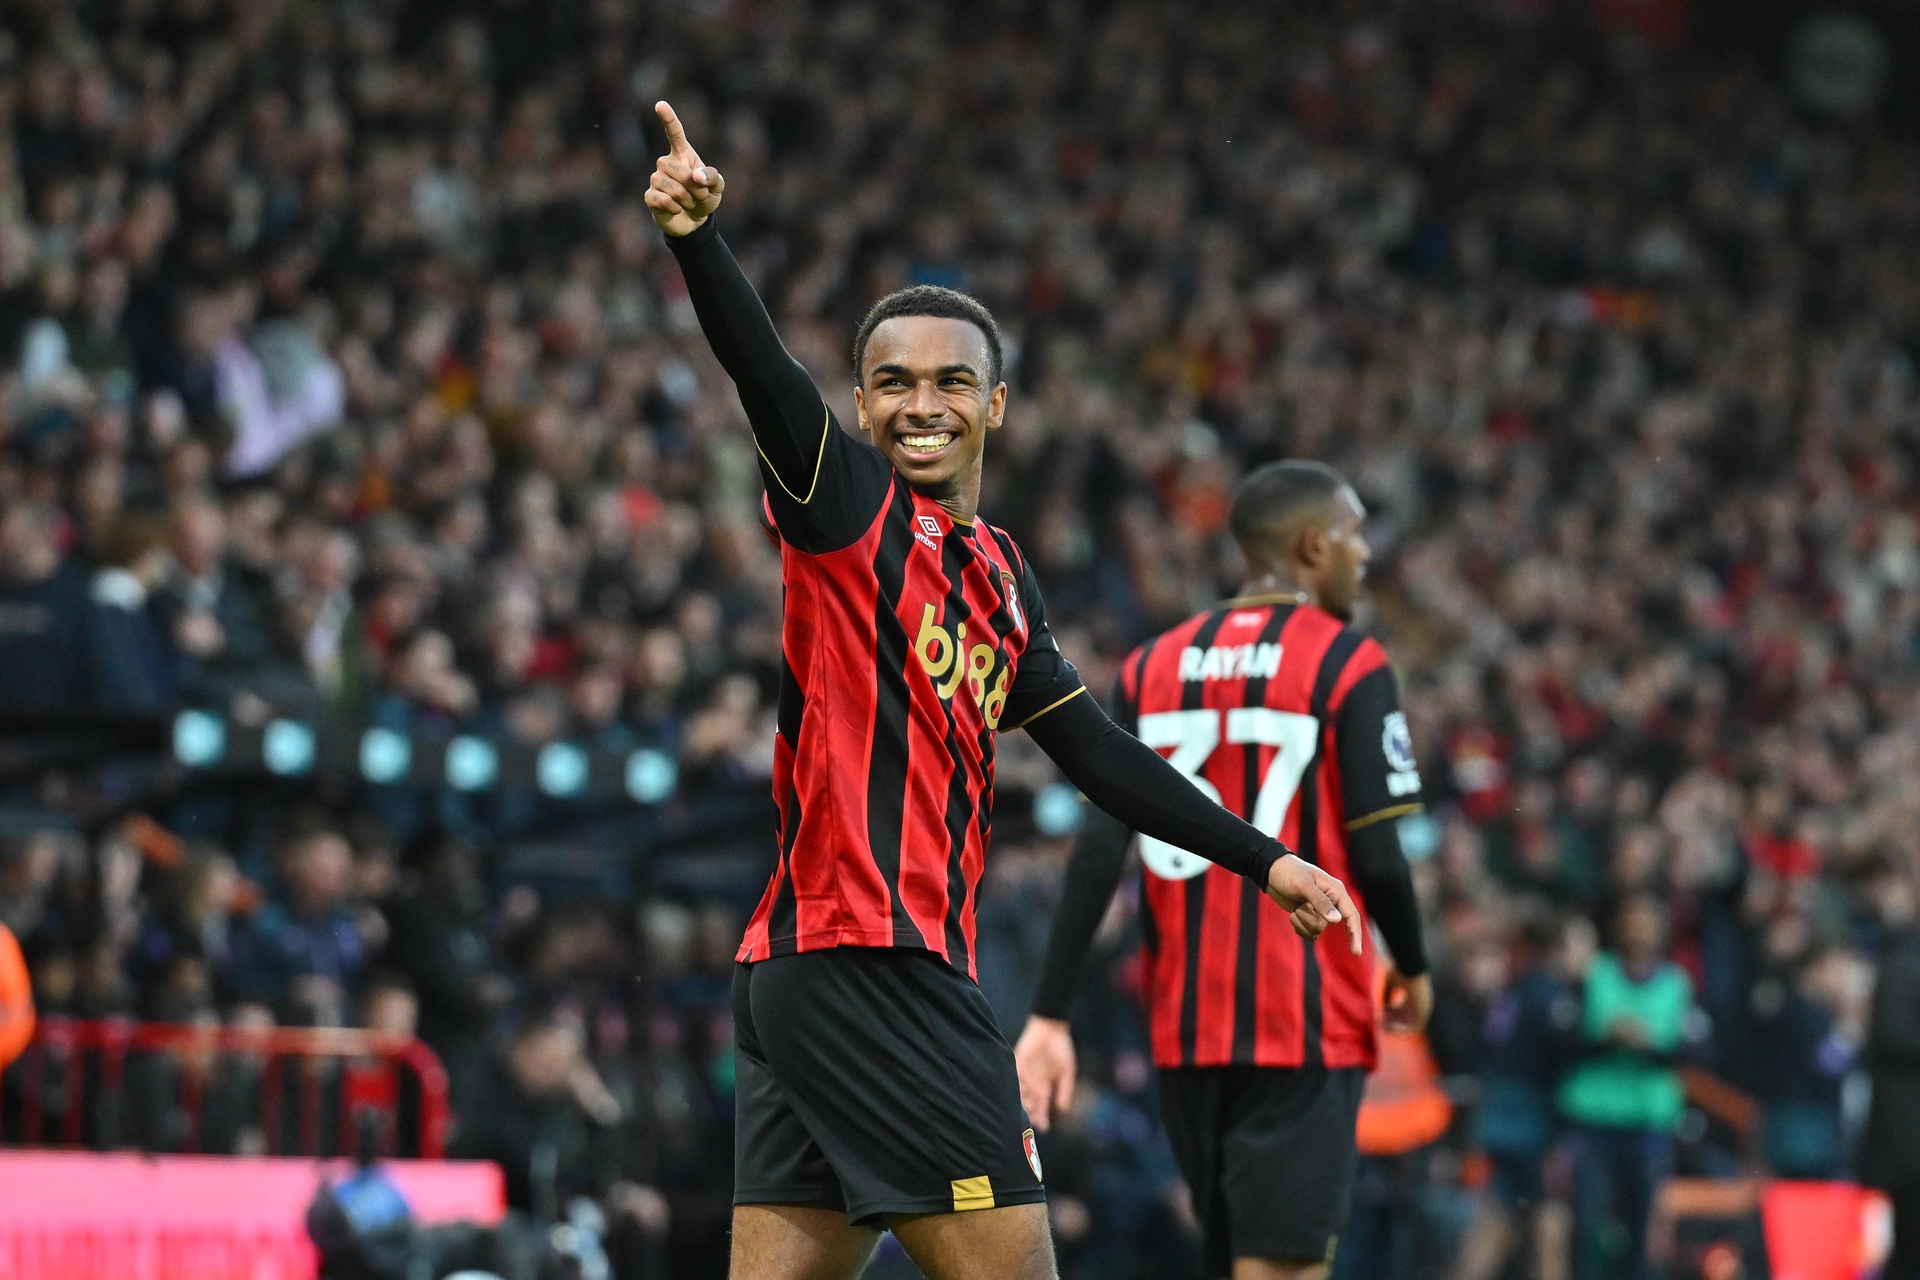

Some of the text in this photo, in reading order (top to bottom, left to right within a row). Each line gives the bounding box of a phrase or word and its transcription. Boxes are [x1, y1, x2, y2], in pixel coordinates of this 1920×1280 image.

[914, 531, 937, 551] umbro
[914, 603, 1008, 730] bj88
[1178, 643, 1283, 682] RAYAN
[1138, 707, 1319, 880] 37
